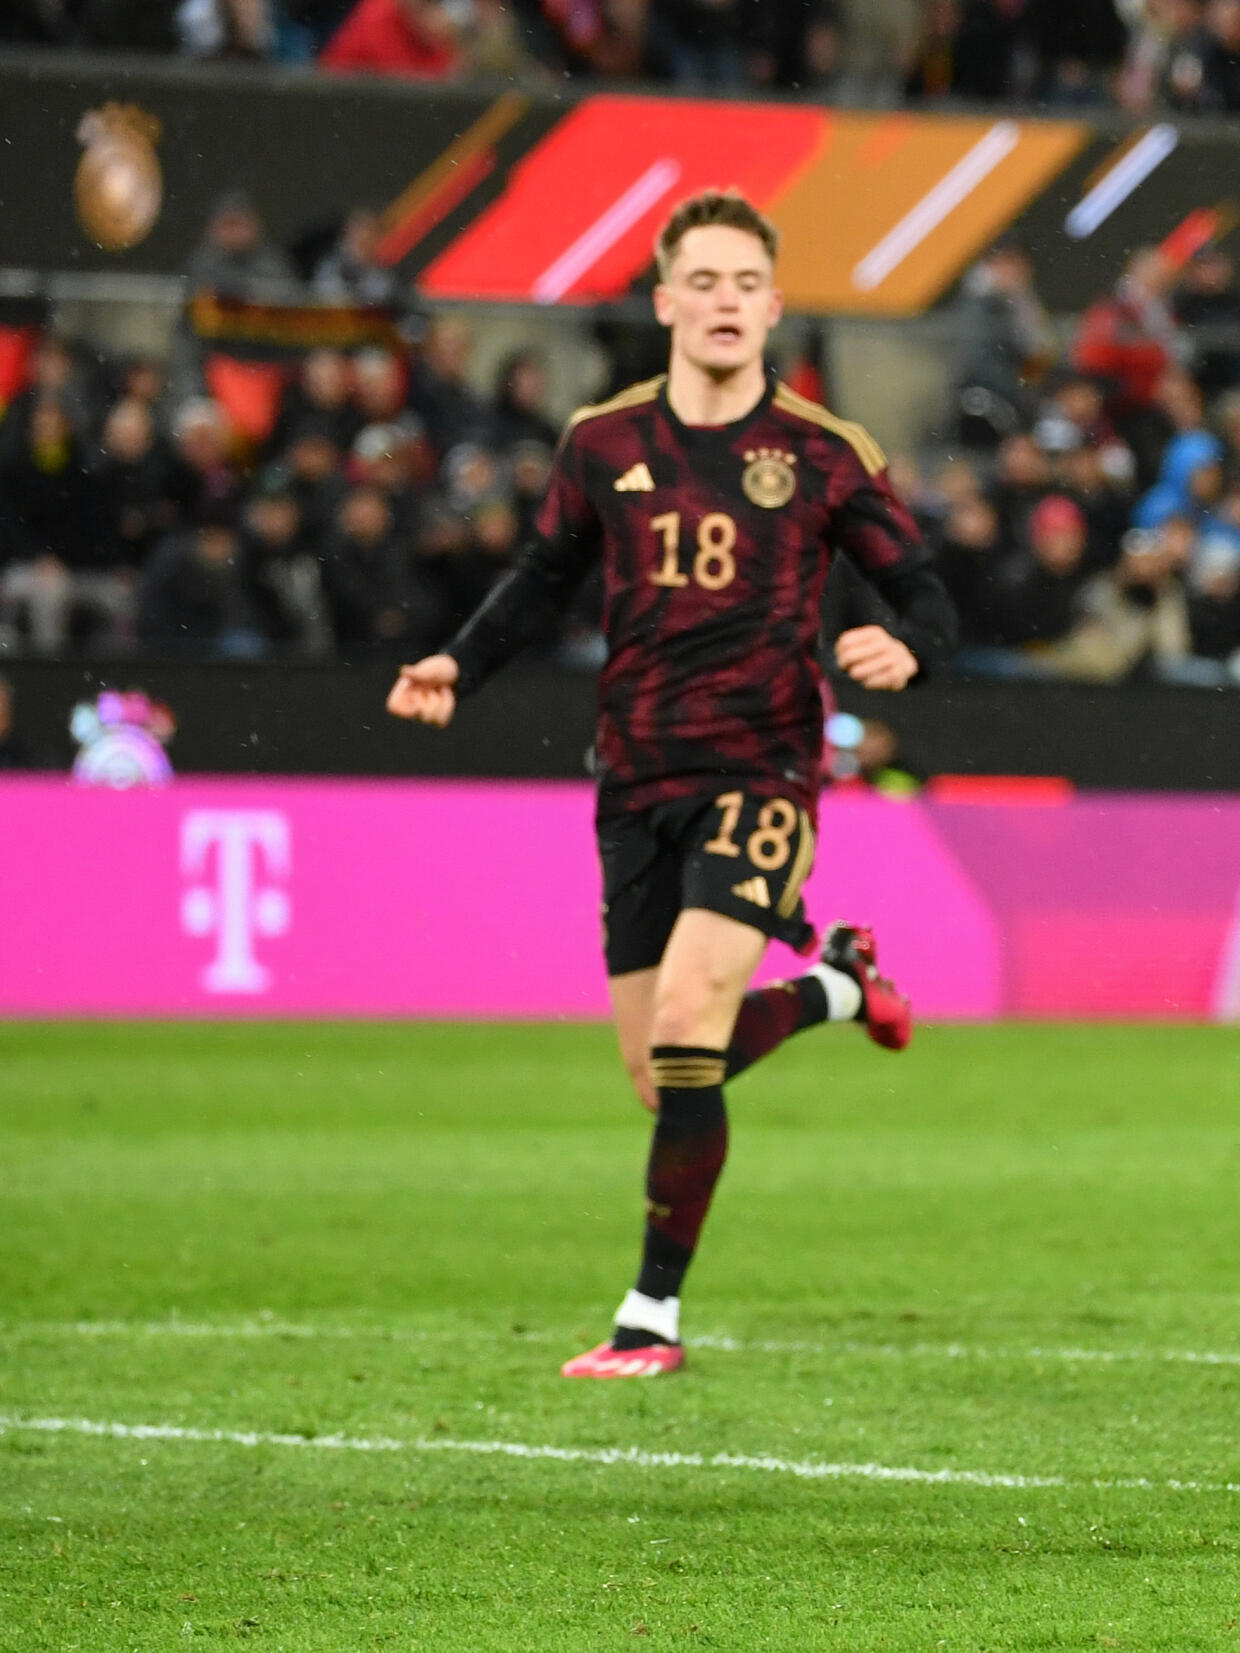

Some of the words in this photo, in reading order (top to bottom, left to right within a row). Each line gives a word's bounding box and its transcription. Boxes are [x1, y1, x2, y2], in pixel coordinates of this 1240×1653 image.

[648, 511, 737, 590] 18
[704, 789, 798, 871] 18
[181, 808, 291, 994] T
